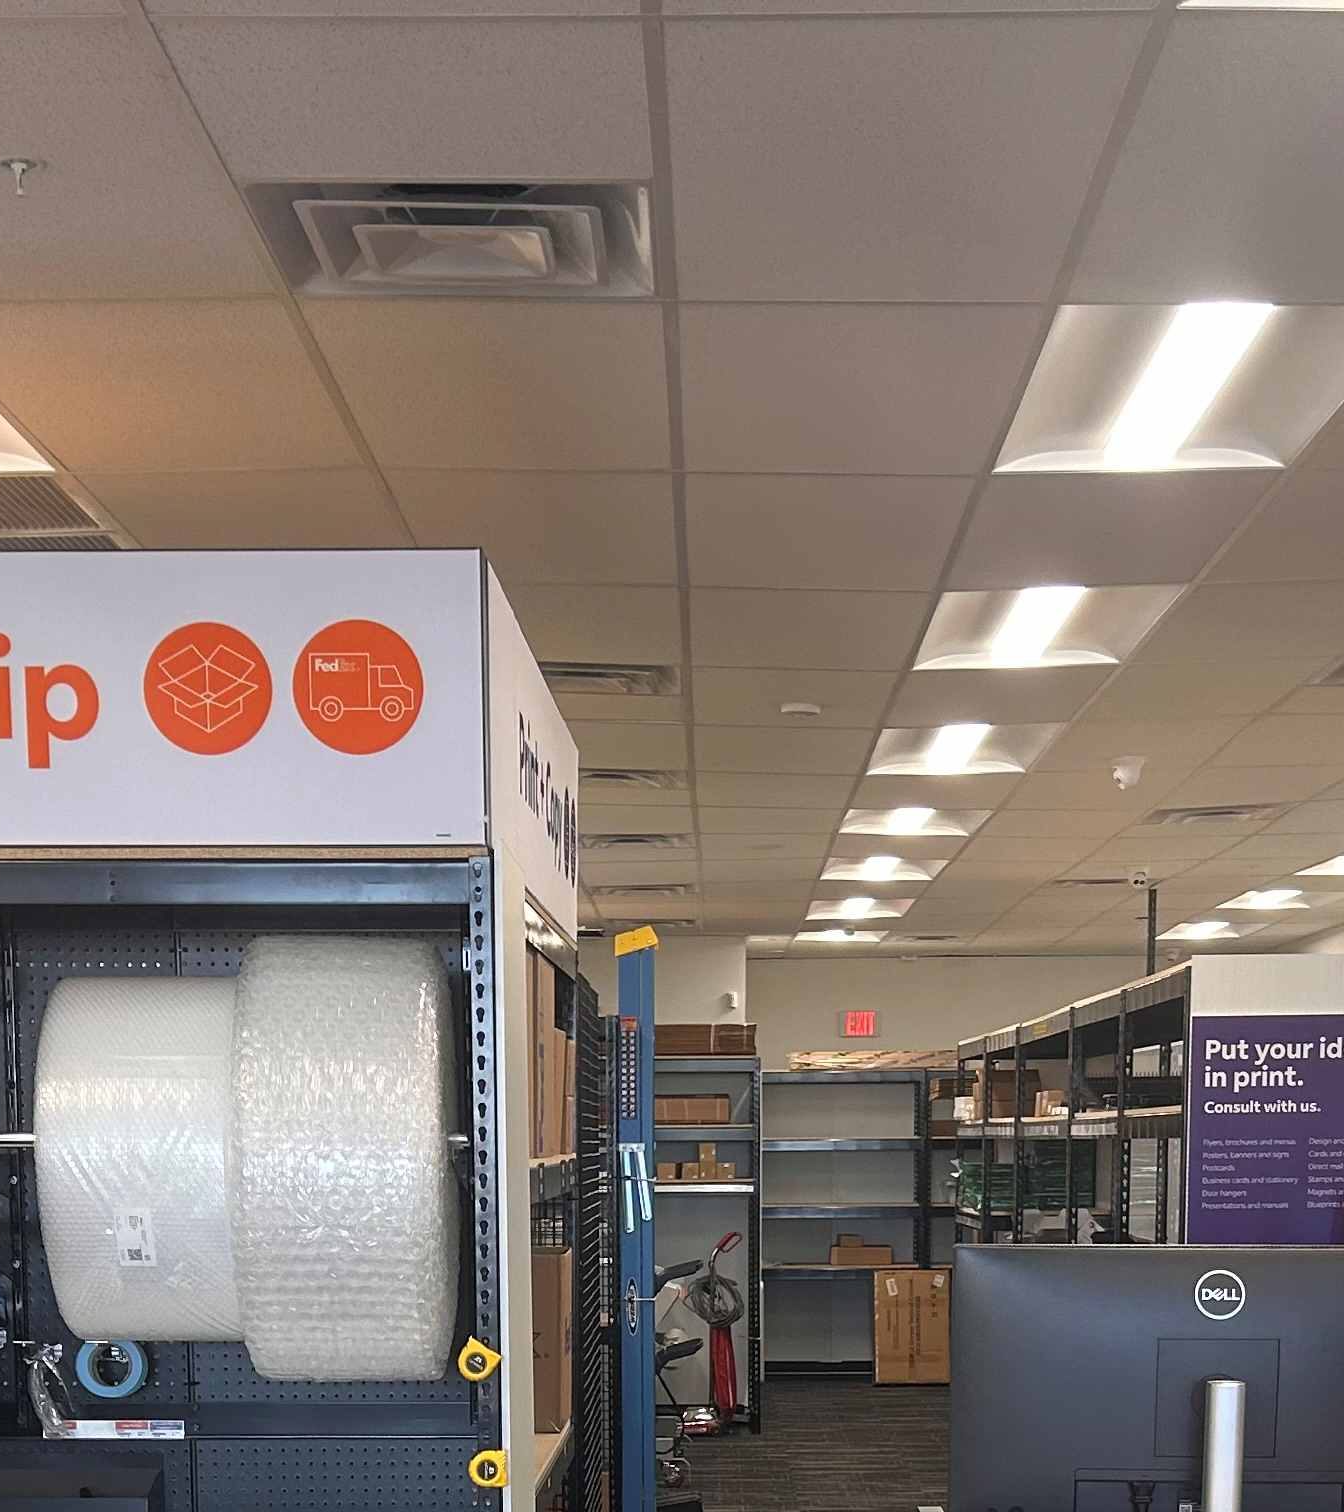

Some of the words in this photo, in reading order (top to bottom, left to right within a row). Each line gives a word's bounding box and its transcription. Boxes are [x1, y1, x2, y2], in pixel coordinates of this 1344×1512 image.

[847, 1011, 875, 1036] EXIT
[1205, 1039, 1249, 1060] Put
[1254, 1041, 1313, 1066] your
[1204, 1066, 1227, 1088] in
[1233, 1065, 1304, 1093] print.
[1204, 1100, 1261, 1114] Consult
[1263, 1099, 1297, 1113] with
[1300, 1101, 1322, 1113] us.
[1201, 1288, 1241, 1301] DELL
